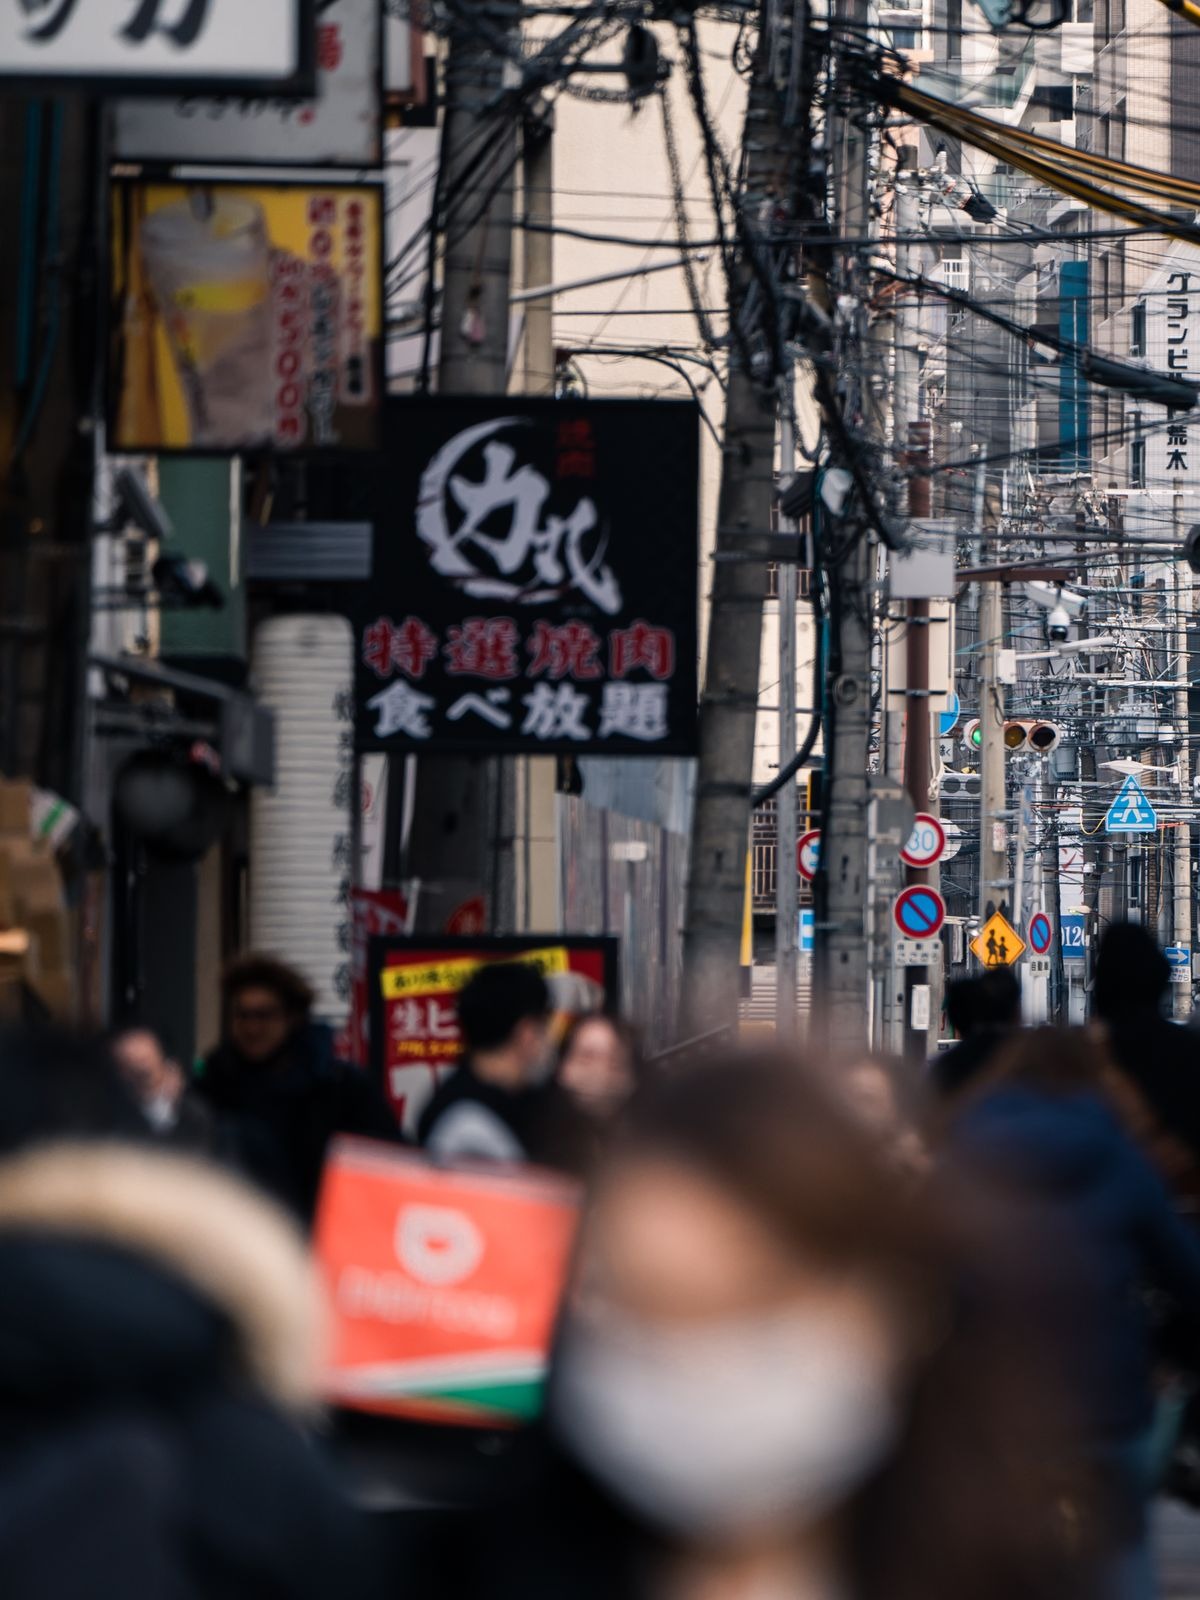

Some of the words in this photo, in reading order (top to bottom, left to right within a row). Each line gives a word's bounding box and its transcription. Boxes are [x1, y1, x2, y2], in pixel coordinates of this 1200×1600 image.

[362, 616, 676, 680] 特選焼肉
[366, 678, 669, 742] 食べ放題
[907, 829, 935, 852] 30
